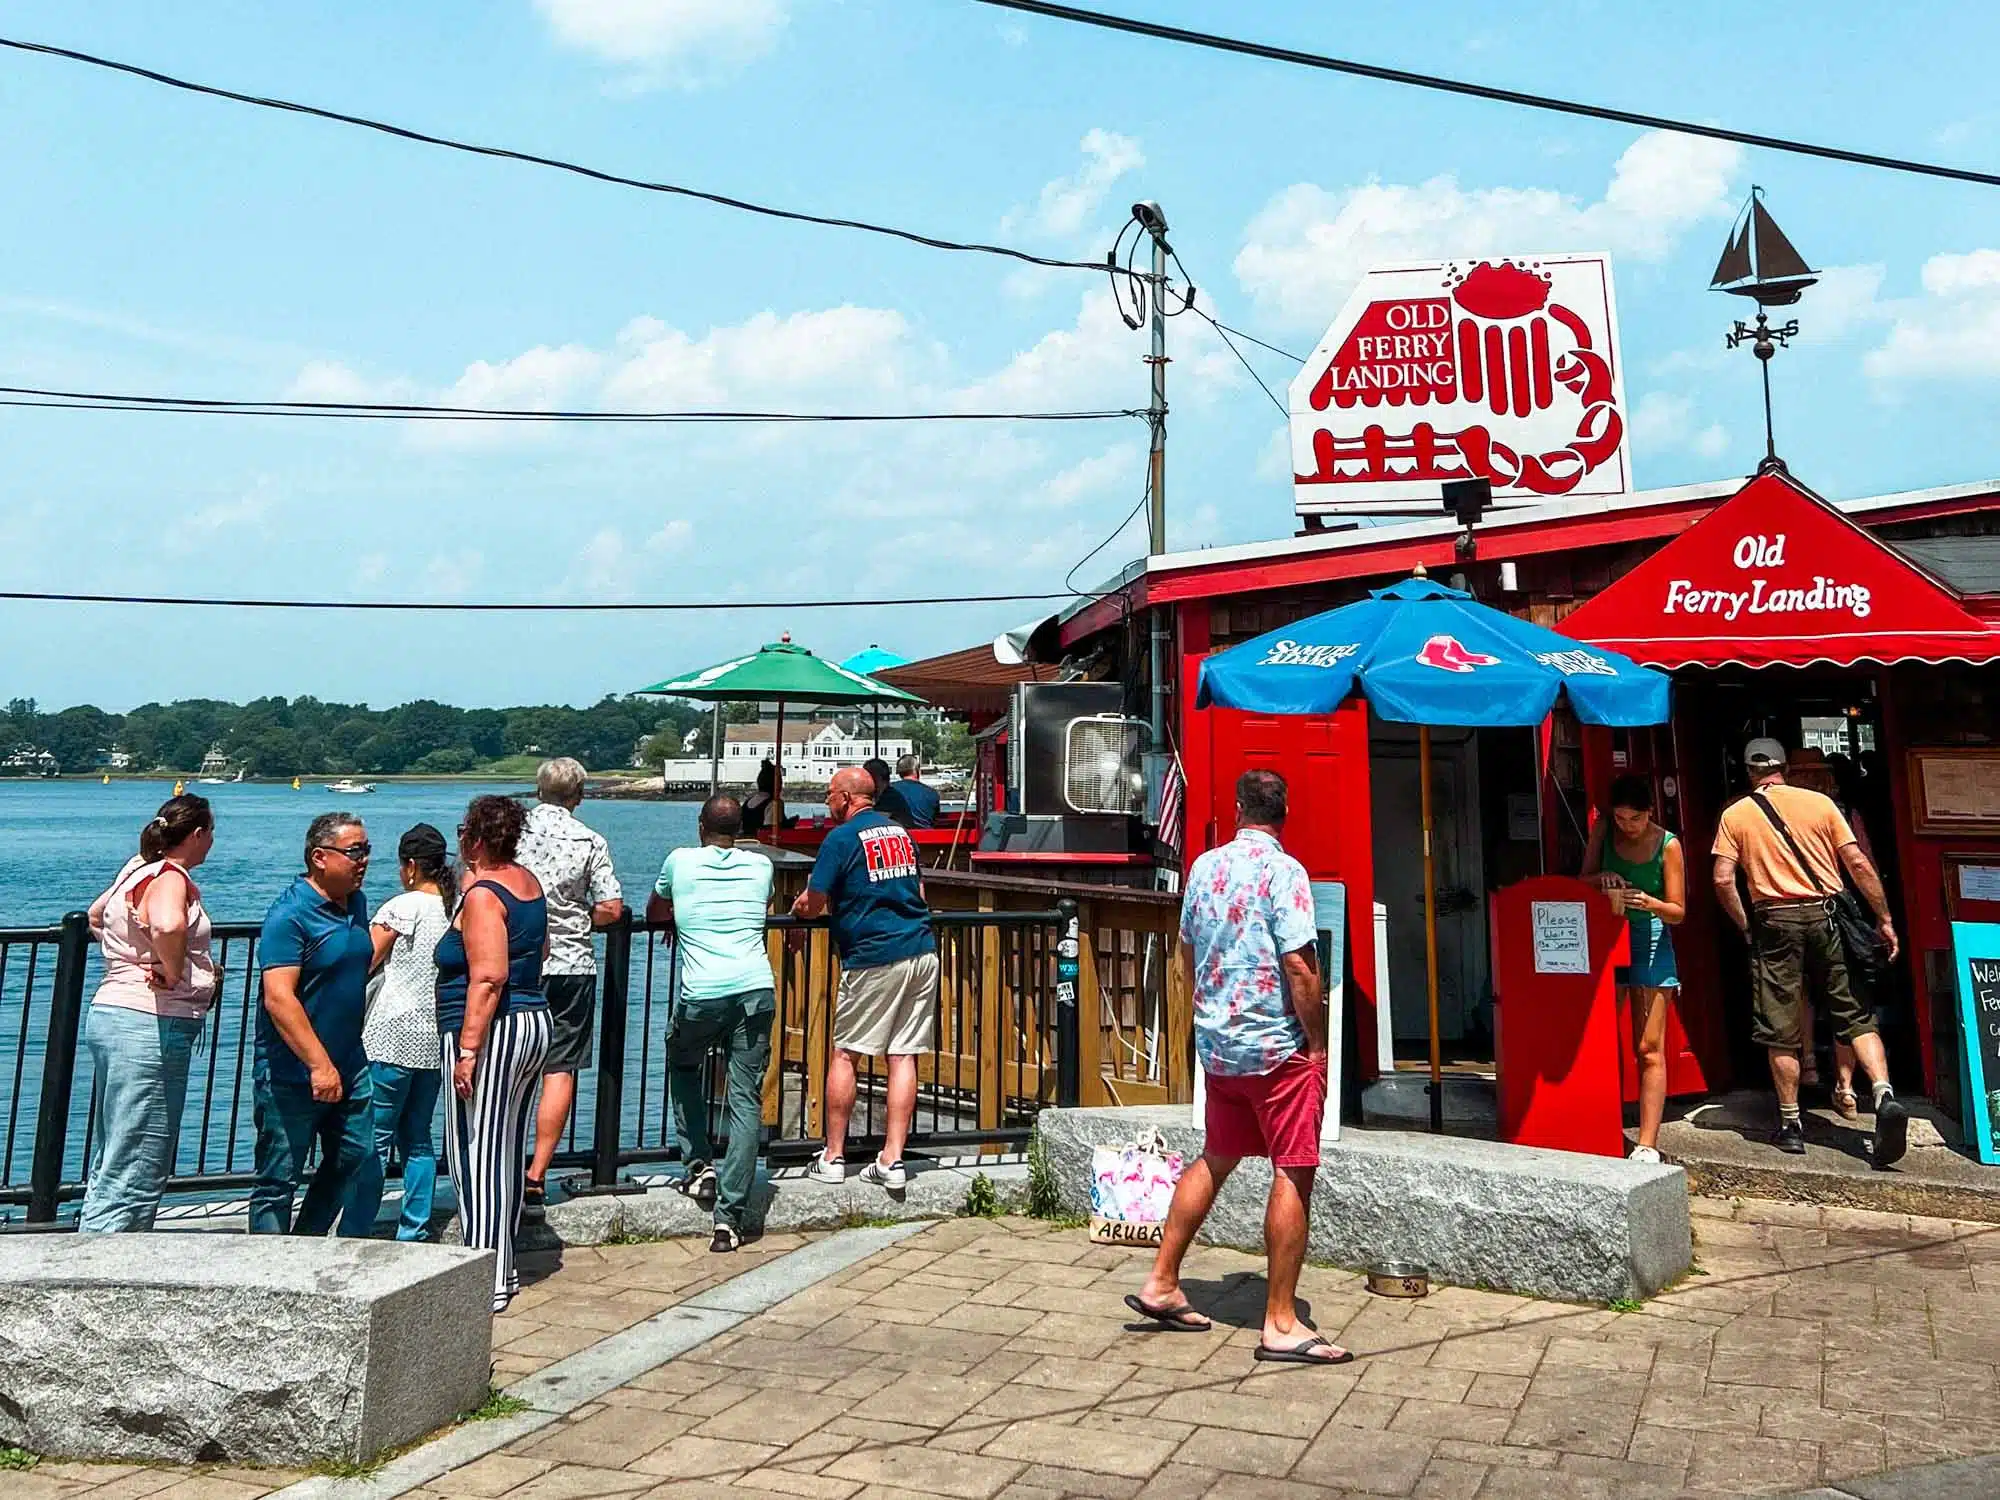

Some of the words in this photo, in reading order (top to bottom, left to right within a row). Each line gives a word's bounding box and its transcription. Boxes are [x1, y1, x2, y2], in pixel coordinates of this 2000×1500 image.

[1386, 304, 1449, 330] OLD
[1357, 332, 1450, 361] FERRY
[1330, 361, 1454, 390] LANDING
[1733, 534, 1786, 569] Old
[1664, 580, 1749, 621] Ferry
[1748, 576, 1871, 617] Landing
[863, 834, 916, 873] FIRE
[1971, 962, 2000, 983] Wel
[1098, 1222, 1163, 1241] ARUBA
